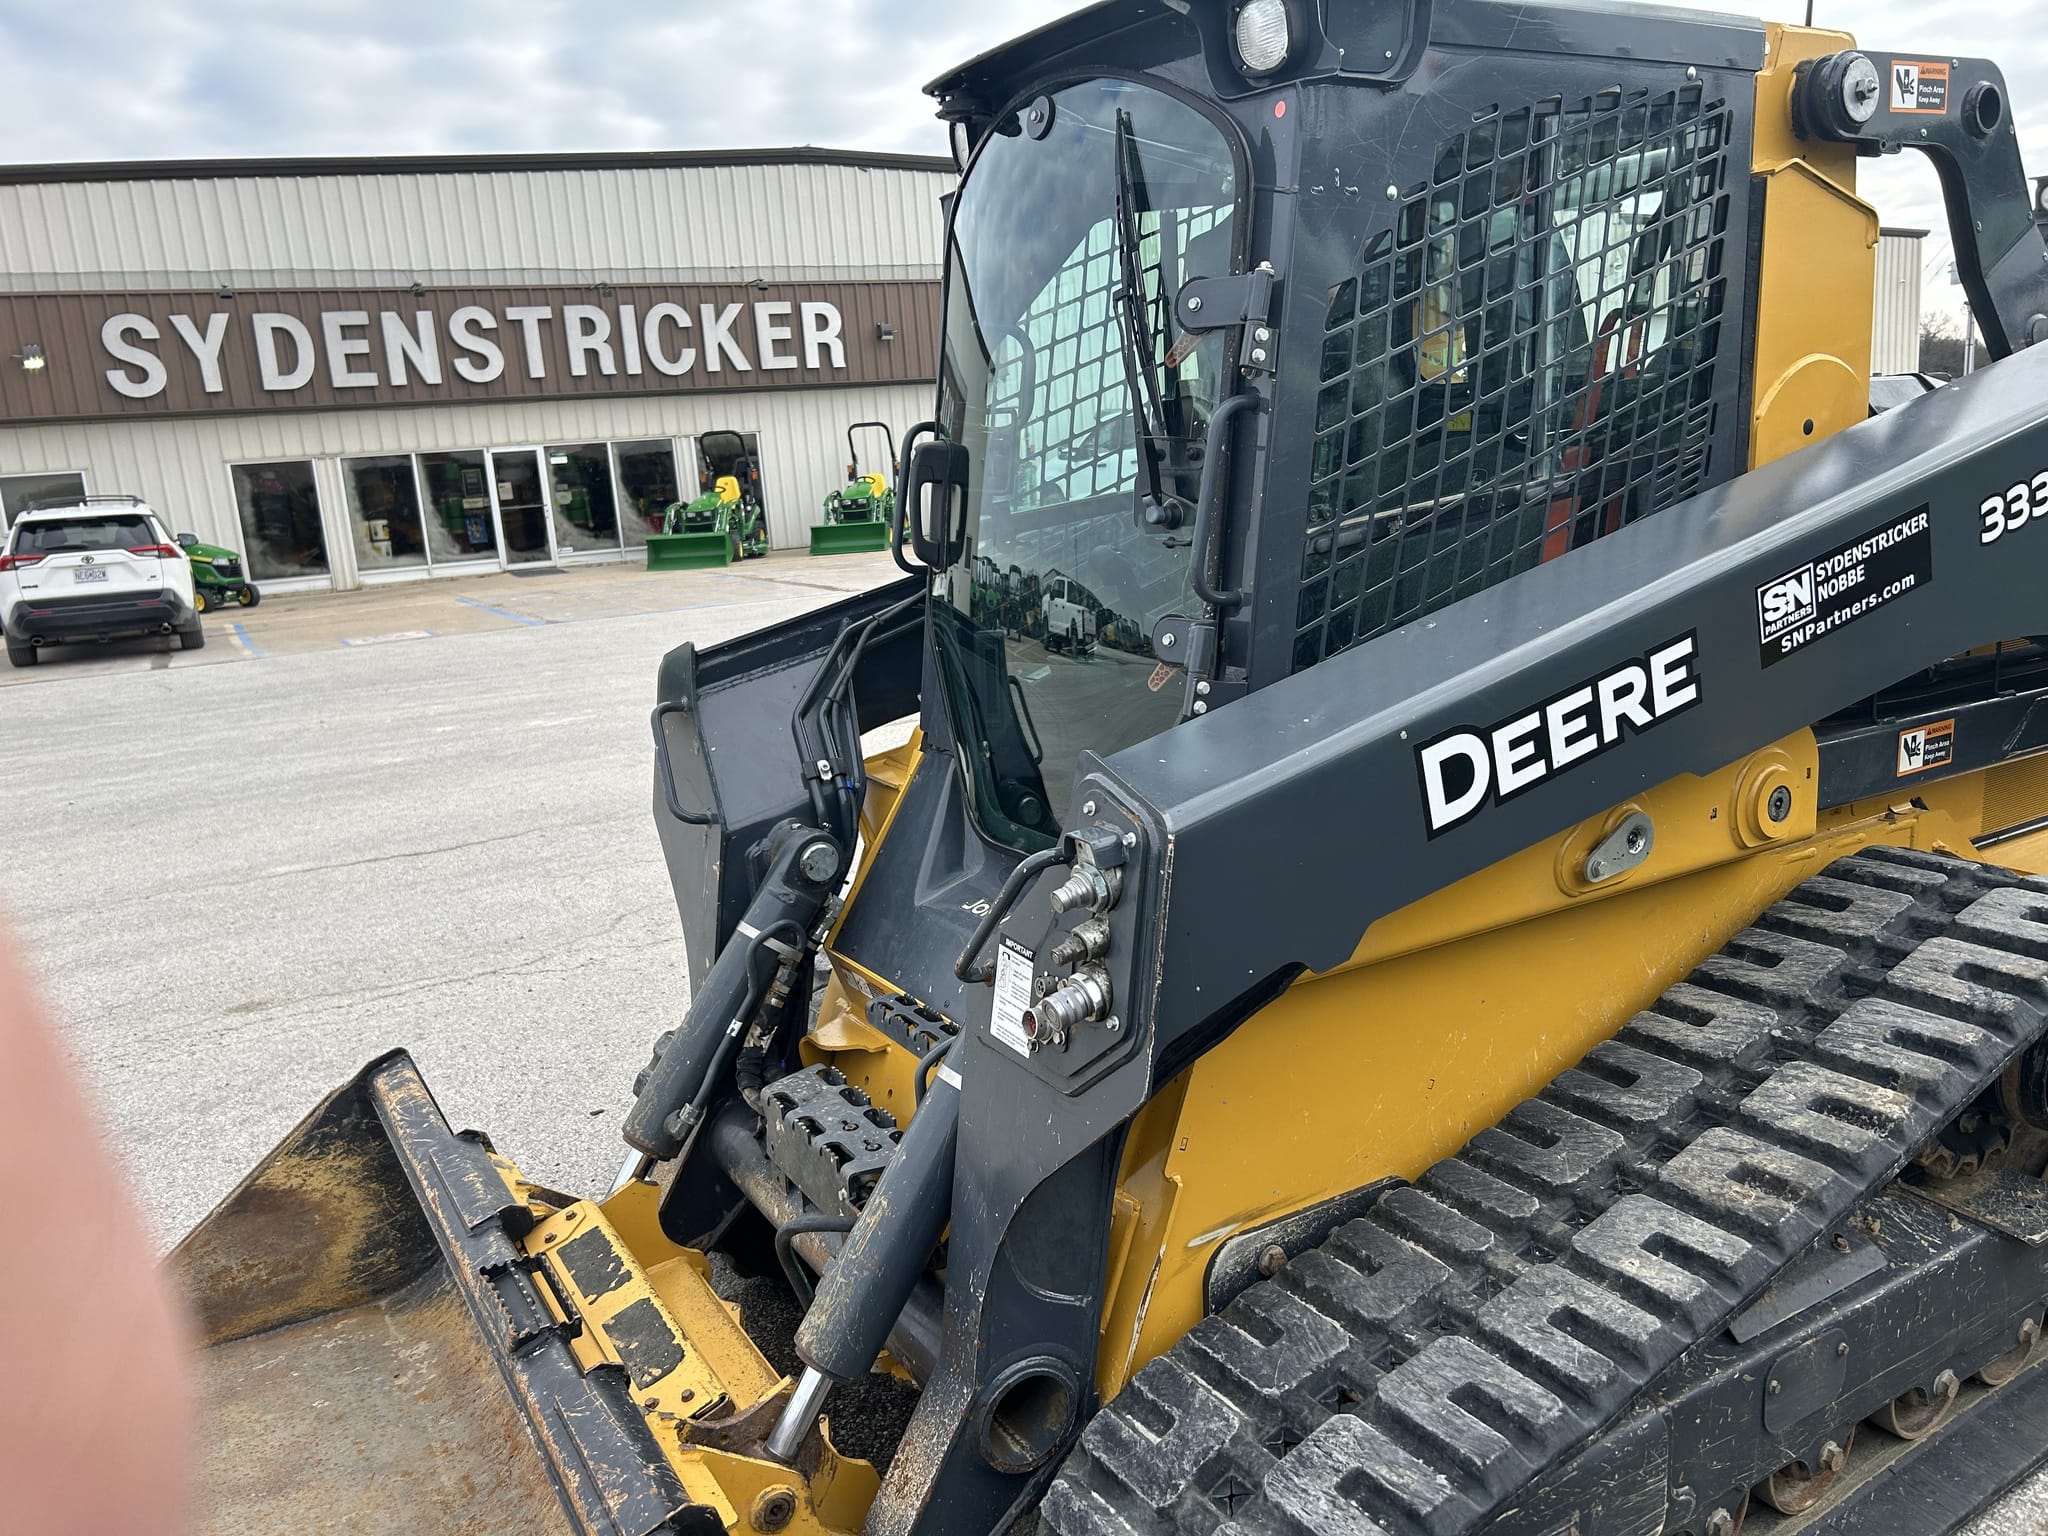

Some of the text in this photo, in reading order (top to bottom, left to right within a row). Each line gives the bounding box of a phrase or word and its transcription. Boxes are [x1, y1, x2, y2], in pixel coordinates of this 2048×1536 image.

[1919, 84, 1933, 93] Pinch
[101, 301, 847, 398] SYDENSTRICKER
[1816, 512, 1928, 582] SYDENSTRICKER
[1817, 564, 1866, 603] NOBBE
[1764, 604, 1813, 637] PARTNERS
[1781, 573, 1915, 653] SNPartners.com
[1421, 637, 1697, 831] DEERE
[1925, 742, 1939, 752] Pinch
[1005, 938, 1034, 959] IMPORTANT
